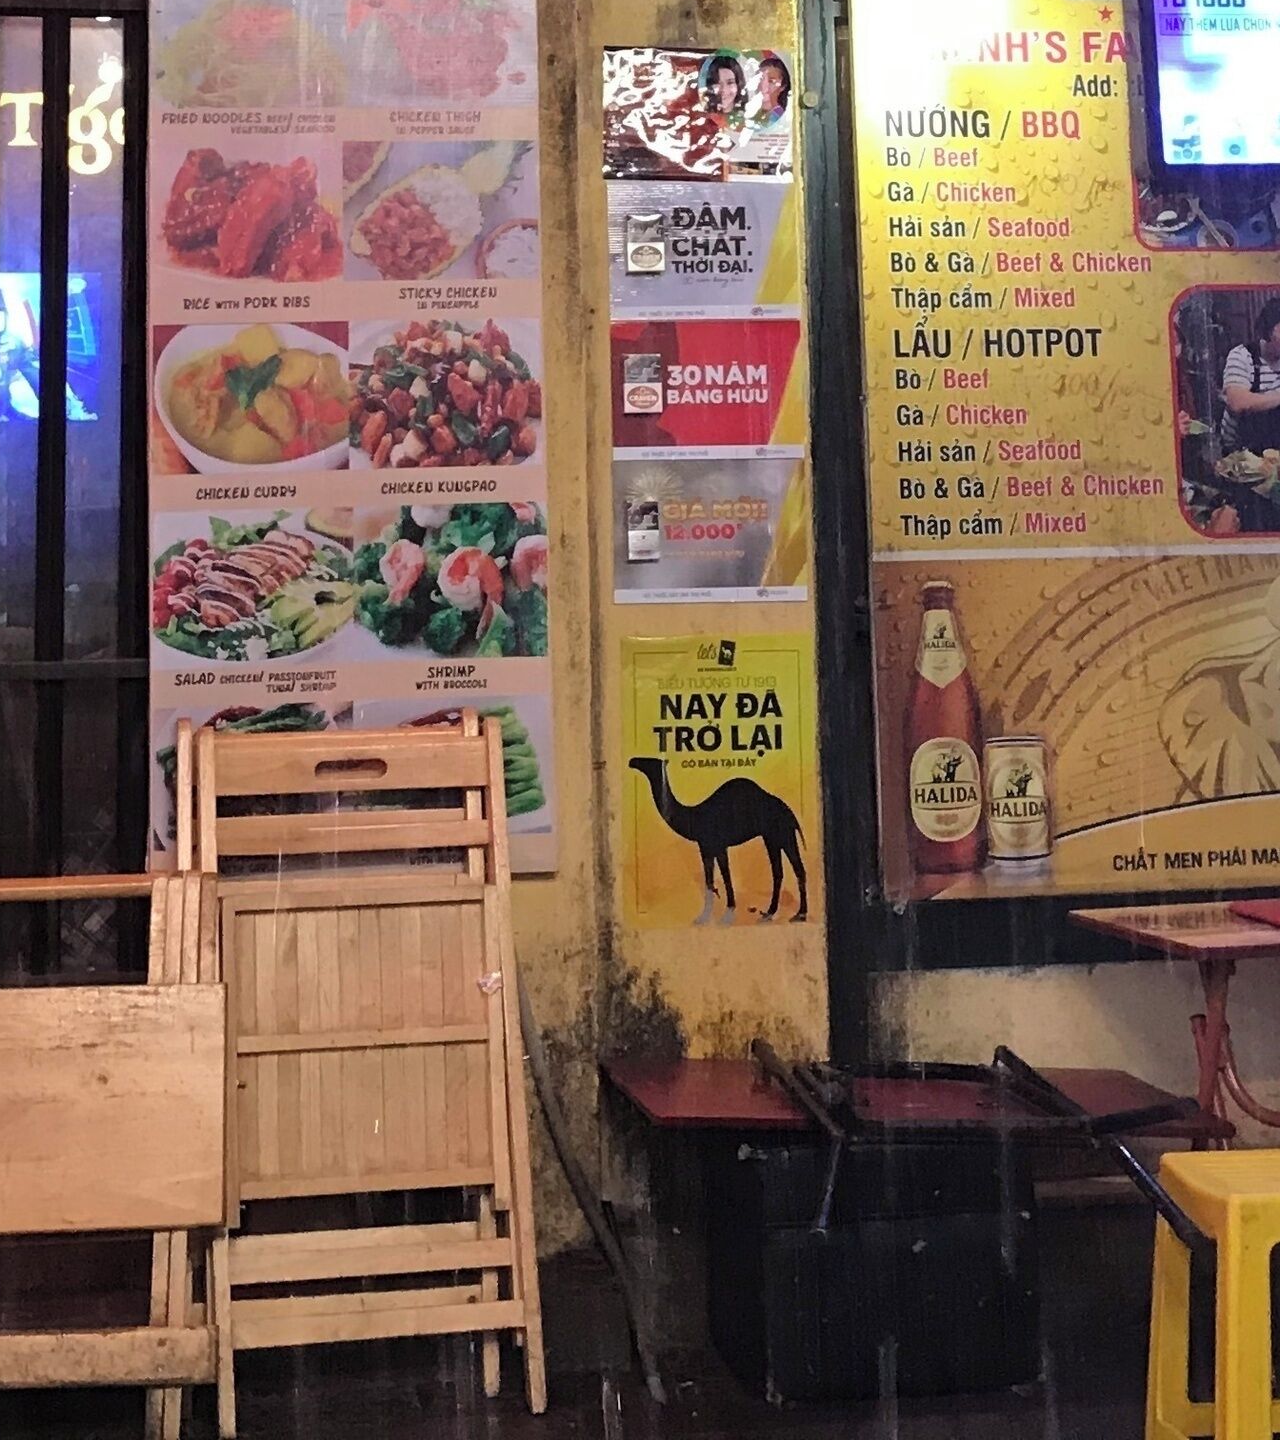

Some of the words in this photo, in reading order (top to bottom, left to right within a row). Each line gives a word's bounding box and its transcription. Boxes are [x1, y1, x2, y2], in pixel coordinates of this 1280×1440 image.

[1073, 75, 1119, 98] Add:
[162, 112, 198, 125] FRIED
[203, 112, 261, 124] NOODLES
[885, 104, 990, 140] NƯỚNG
[1022, 110, 1081, 140] BBQ
[887, 147, 911, 167] Bò
[934, 147, 978, 167] Beef
[888, 182, 914, 203] Gà
[937, 181, 1016, 203] Chicken
[889, 217, 922, 238] Hải
[931, 217, 966, 238] sản
[988, 217, 1071, 238] Seafood
[891, 252, 916, 273] Bò
[924, 253, 939, 273] &
[947, 251, 975, 273] Gà
[997, 252, 1041, 273] Beef
[1050, 252, 1065, 272] &
[1073, 252, 1152, 273] Chicken
[183, 297, 210, 310] RICE
[244, 296, 278, 310] PORK
[283, 296, 311, 309] RIBS
[400, 287, 442, 299] STICKY
[446, 286, 497, 299] CHICKEN
[891, 287, 942, 313] Thập
[949, 284, 992, 308] cẩm
[1015, 288, 1075, 308] Mixed
[894, 317, 952, 358] LẨU
[984, 328, 1102, 358] HOTPOT
[667, 365, 701, 386] 30
[896, 368, 921, 390] Bò
[943, 368, 989, 389] Beef
[897, 404, 923, 426] Gà
[947, 404, 1027, 426] Chicken
[898, 441, 932, 462] Hải
[940, 441, 976, 462] sản
[998, 440, 1082, 461] Seafood
[195, 486, 250, 501] CHICKEN
[254, 485, 297, 499] CURRY
[381, 481, 434, 495] CHICKEN
[438, 480, 497, 494] KUNGPAO
[900, 477, 926, 499] Bò
[934, 479, 949, 499] &
[958, 477, 985, 498] Gà
[1008, 477, 1053, 497] Beef
[1061, 476, 1075, 496] &
[1084, 475, 1164, 496] Chicken
[901, 514, 951, 540] Thập
[960, 511, 1003, 535] cẩm
[1026, 513, 1087, 533] Mixed
[175, 672, 216, 686] SALAD
[428, 665, 476, 678] SHRIMP
[660, 693, 728, 720] NAY
[735, 688, 783, 718] ĐÃ
[653, 720, 722, 752] TRỞ
[731, 724, 782, 757] LẠI
[914, 786, 978, 804] HALIDA
[990, 800, 1047, 818] HALIDA
[1163, 853, 1203, 870] MEN
